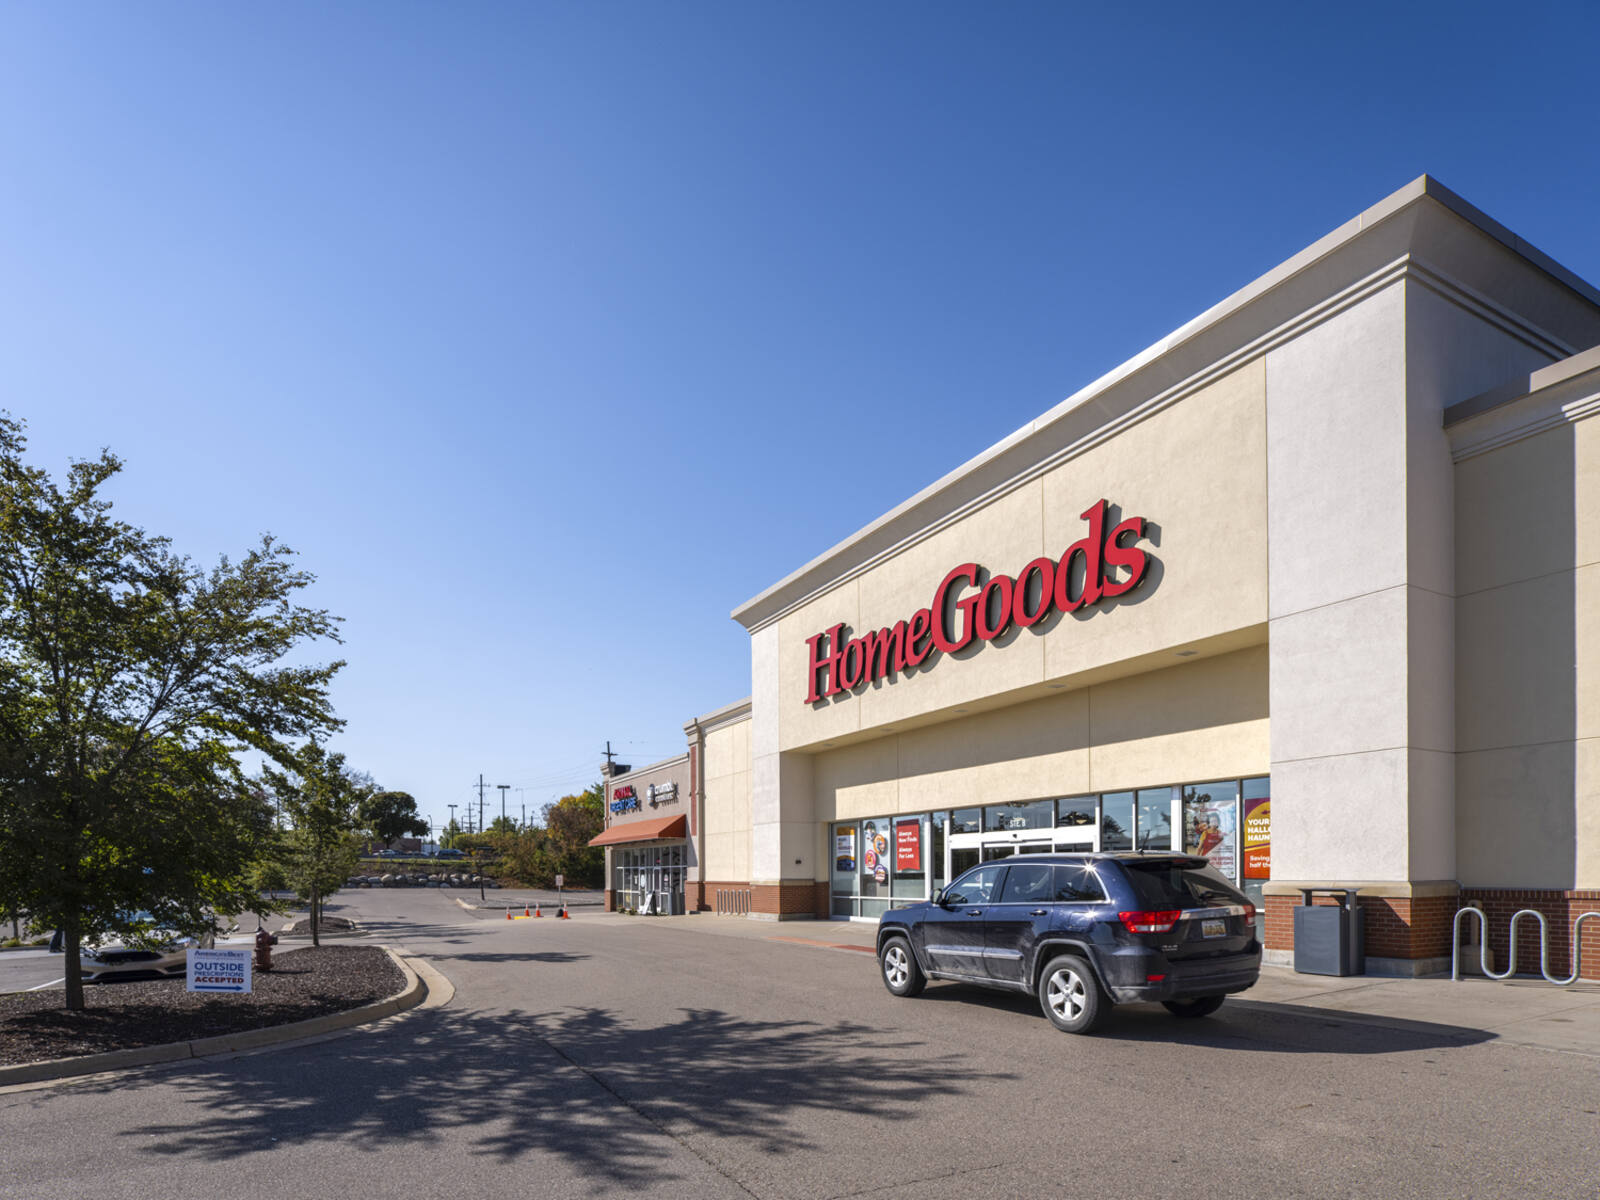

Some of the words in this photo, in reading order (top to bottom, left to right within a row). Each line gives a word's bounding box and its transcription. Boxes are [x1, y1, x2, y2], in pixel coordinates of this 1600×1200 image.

[804, 498, 1147, 705] HomeGoods
[1248, 818, 1270, 826] YOUR
[194, 962, 244, 971] OUTSIDE
